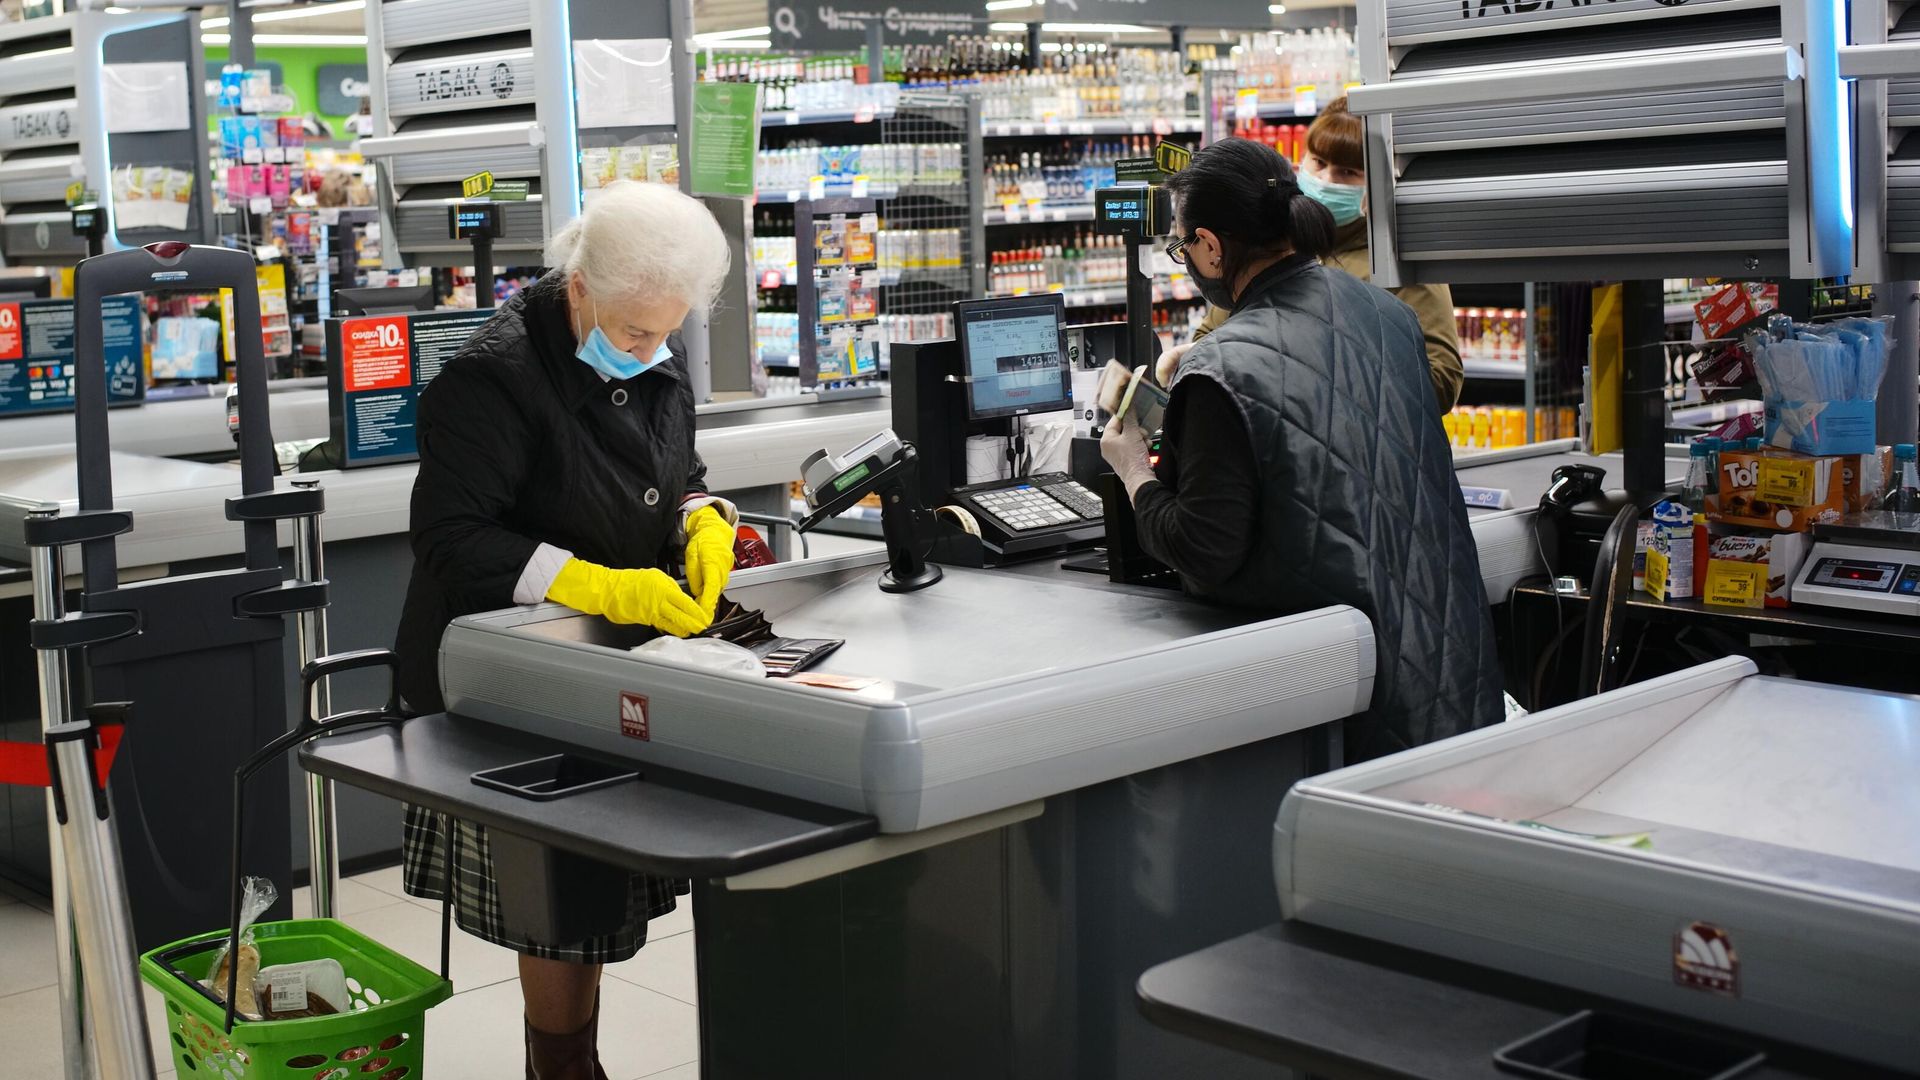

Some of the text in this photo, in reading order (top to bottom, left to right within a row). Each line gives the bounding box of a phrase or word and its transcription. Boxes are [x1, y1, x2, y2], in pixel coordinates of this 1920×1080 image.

[416, 65, 481, 101] ТАБАК
[12, 111, 52, 139] ТАБАК
[352, 331, 379, 340] СКИДКА
[1021, 355, 1058, 367] 1473,00
[1718, 540, 1756, 552] bueno
